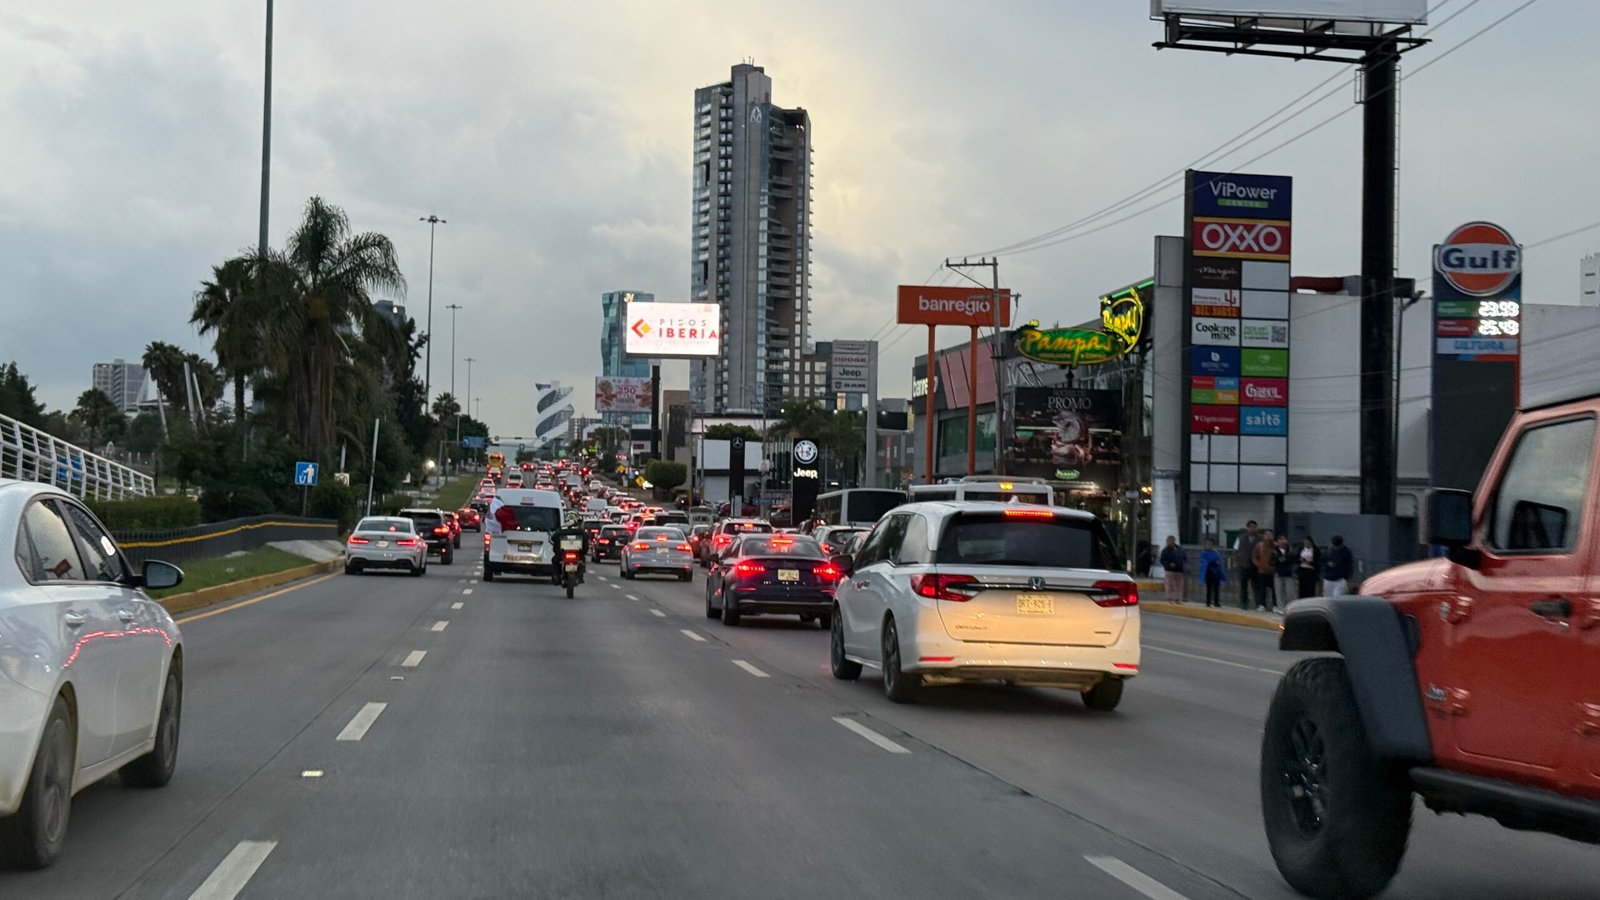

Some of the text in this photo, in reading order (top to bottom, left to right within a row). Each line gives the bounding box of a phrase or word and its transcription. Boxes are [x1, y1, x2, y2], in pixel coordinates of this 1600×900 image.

[1209, 181, 1277, 200] ViPower
[1202, 223, 1282, 253] OXXO
[1442, 247, 1517, 269] Gulf
[918, 295, 990, 316] banregio
[660, 318, 707, 327] PISOS
[1195, 322, 1237, 337] Cooking
[659, 327, 718, 339] IBERIA
[1211, 332, 1231, 341] mix
[1024, 329, 1112, 367] Pampas
[839, 367, 862, 378] Jeep
[1047, 396, 1092, 410] PROMO
[794, 468, 818, 479] Jeep
